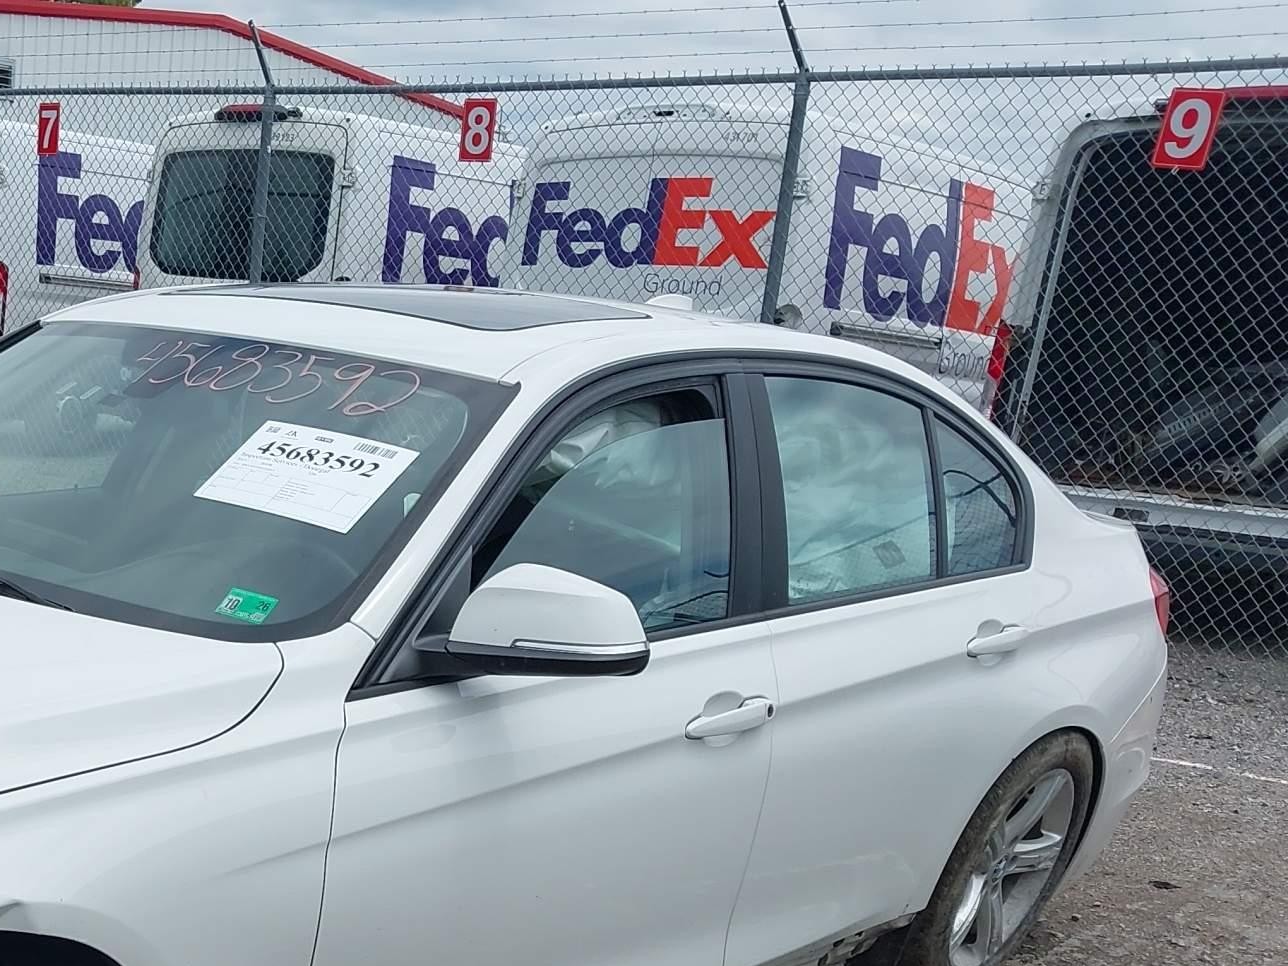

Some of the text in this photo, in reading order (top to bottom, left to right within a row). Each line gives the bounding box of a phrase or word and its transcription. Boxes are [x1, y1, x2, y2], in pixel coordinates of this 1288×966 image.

[41, 110, 58, 149] 7
[464, 107, 490, 154] 8
[1164, 98, 1212, 159] 9
[521, 177, 777, 270] FedEx
[823, 145, 1021, 338] FedEx
[643, 273, 722, 296] Ground
[132, 340, 421, 416] 45683592
[256, 440, 381, 478] 45683592
